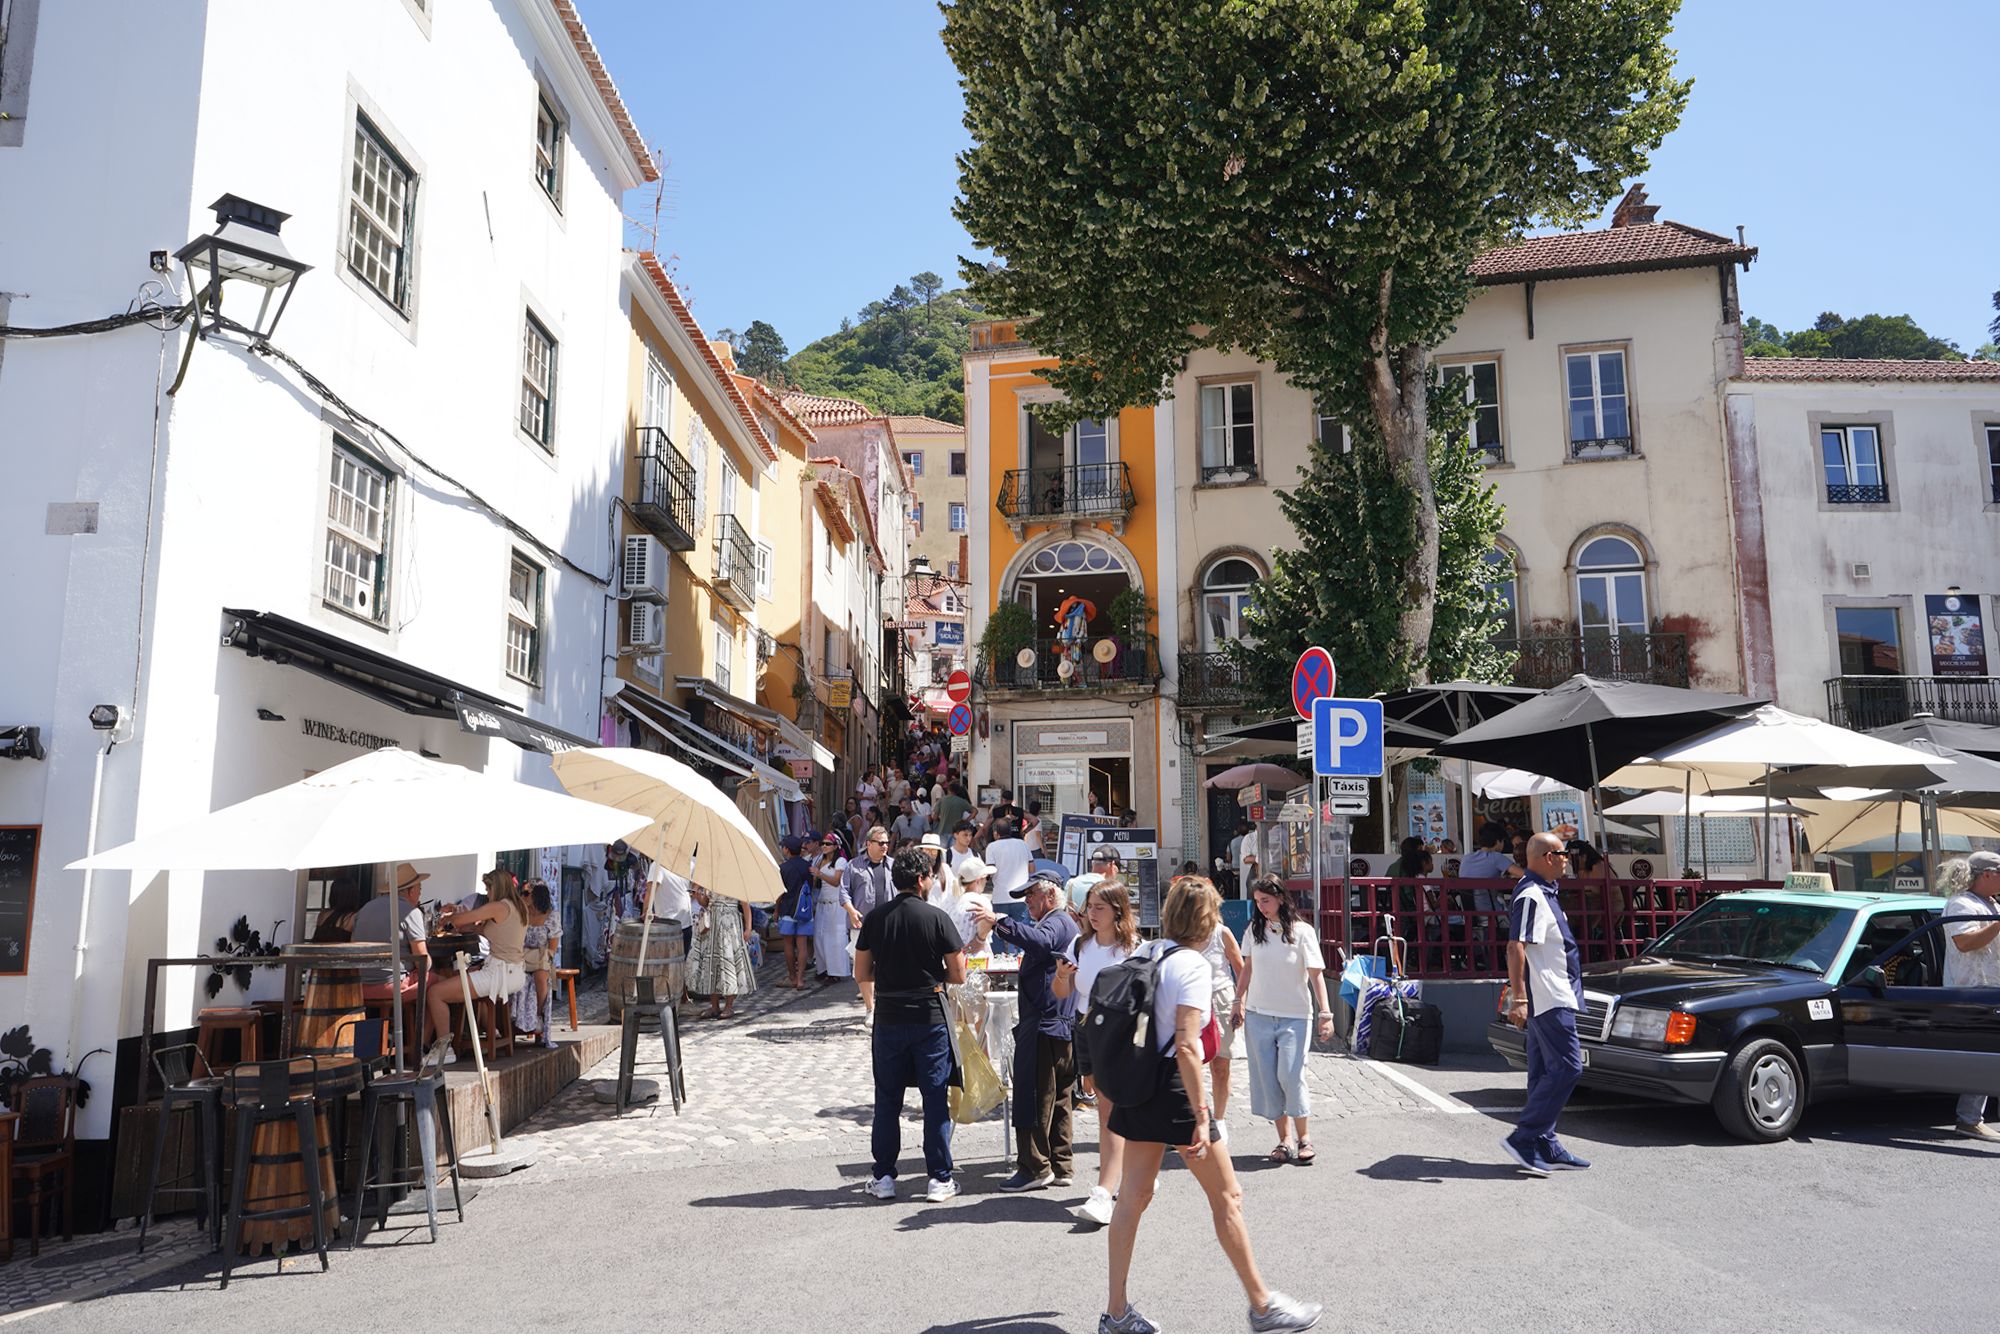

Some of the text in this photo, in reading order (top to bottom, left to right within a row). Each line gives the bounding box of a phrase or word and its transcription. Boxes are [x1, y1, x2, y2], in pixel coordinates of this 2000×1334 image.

[1330, 708, 1368, 768] P
[1333, 780, 1365, 792] Táxis
[1113, 831, 1130, 841] MENU
[1793, 876, 1811, 885] TAXI
[1897, 879, 1920, 887] ATM
[1813, 1000, 1825, 1010] 47
